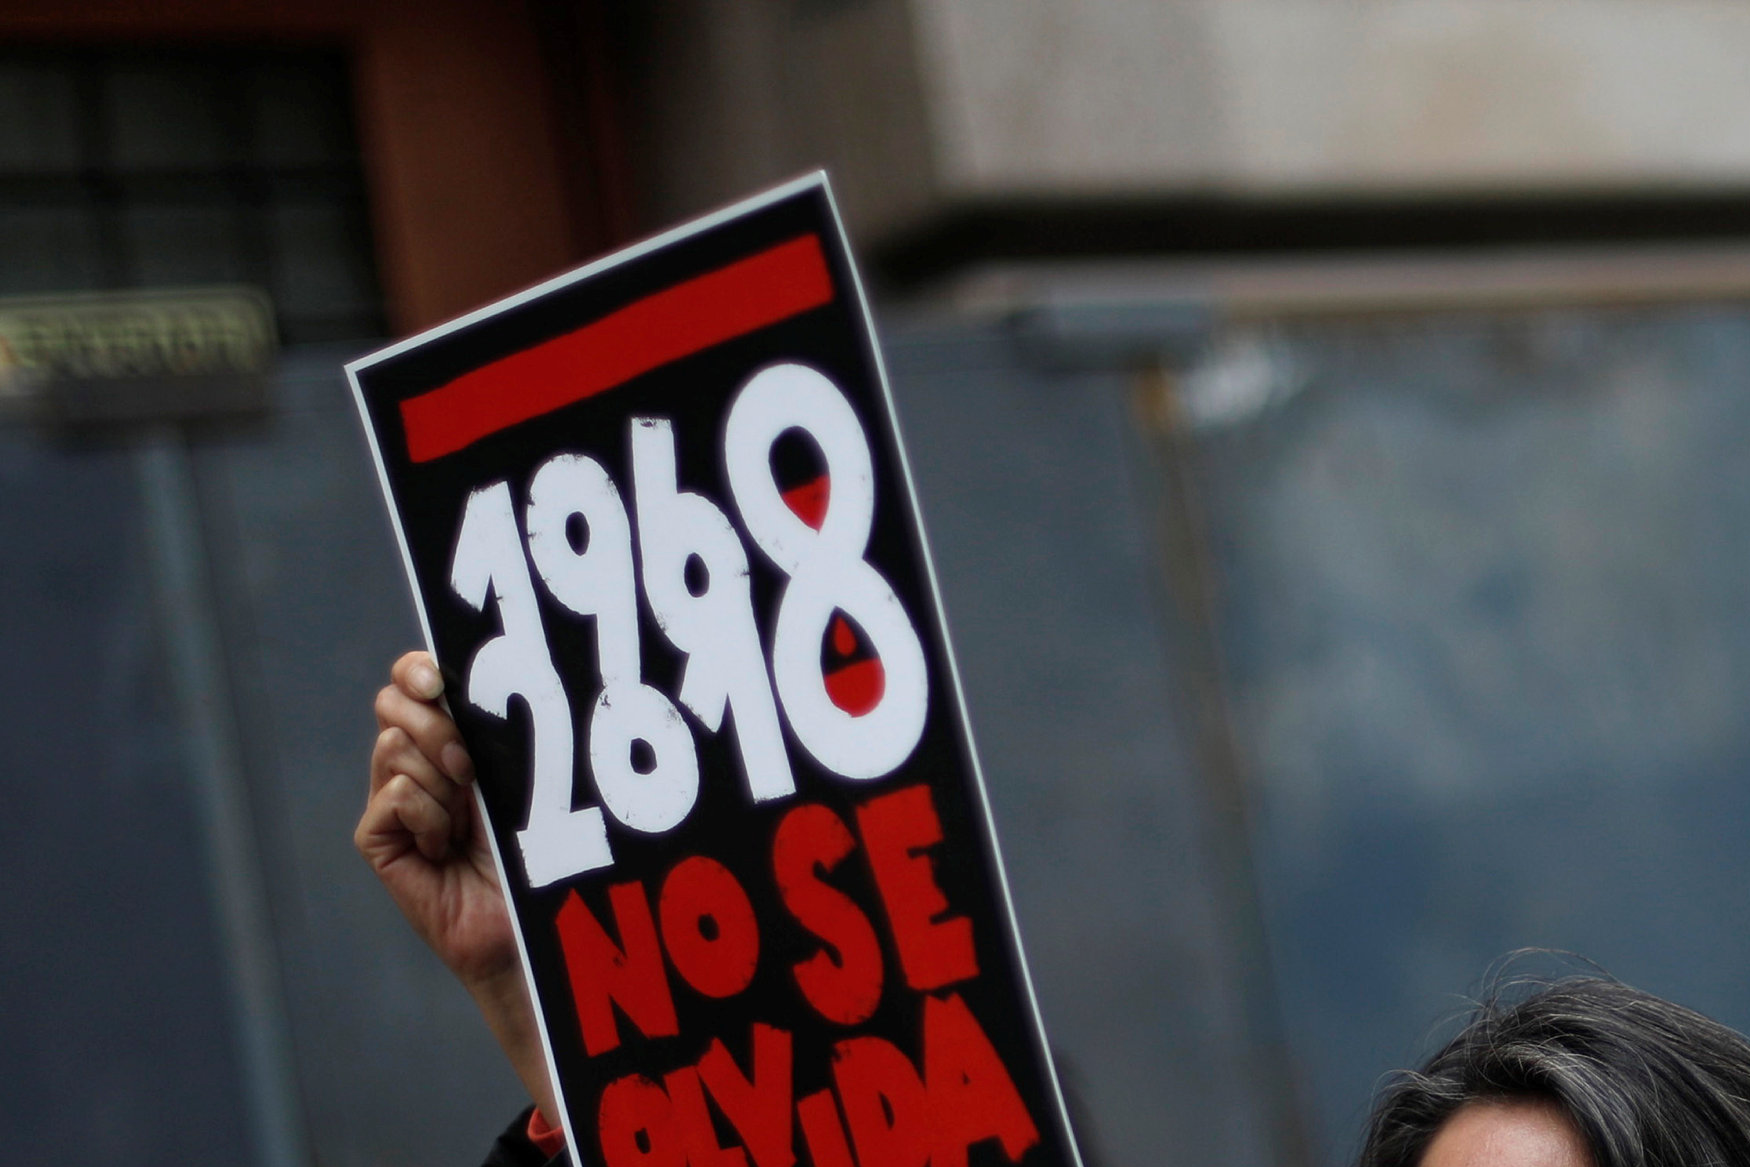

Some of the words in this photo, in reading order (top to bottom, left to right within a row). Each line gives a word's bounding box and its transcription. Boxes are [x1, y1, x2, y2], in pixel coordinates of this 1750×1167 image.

[451, 364, 928, 778] 1968
[555, 856, 759, 1057] NO
[773, 785, 979, 1025] SE
